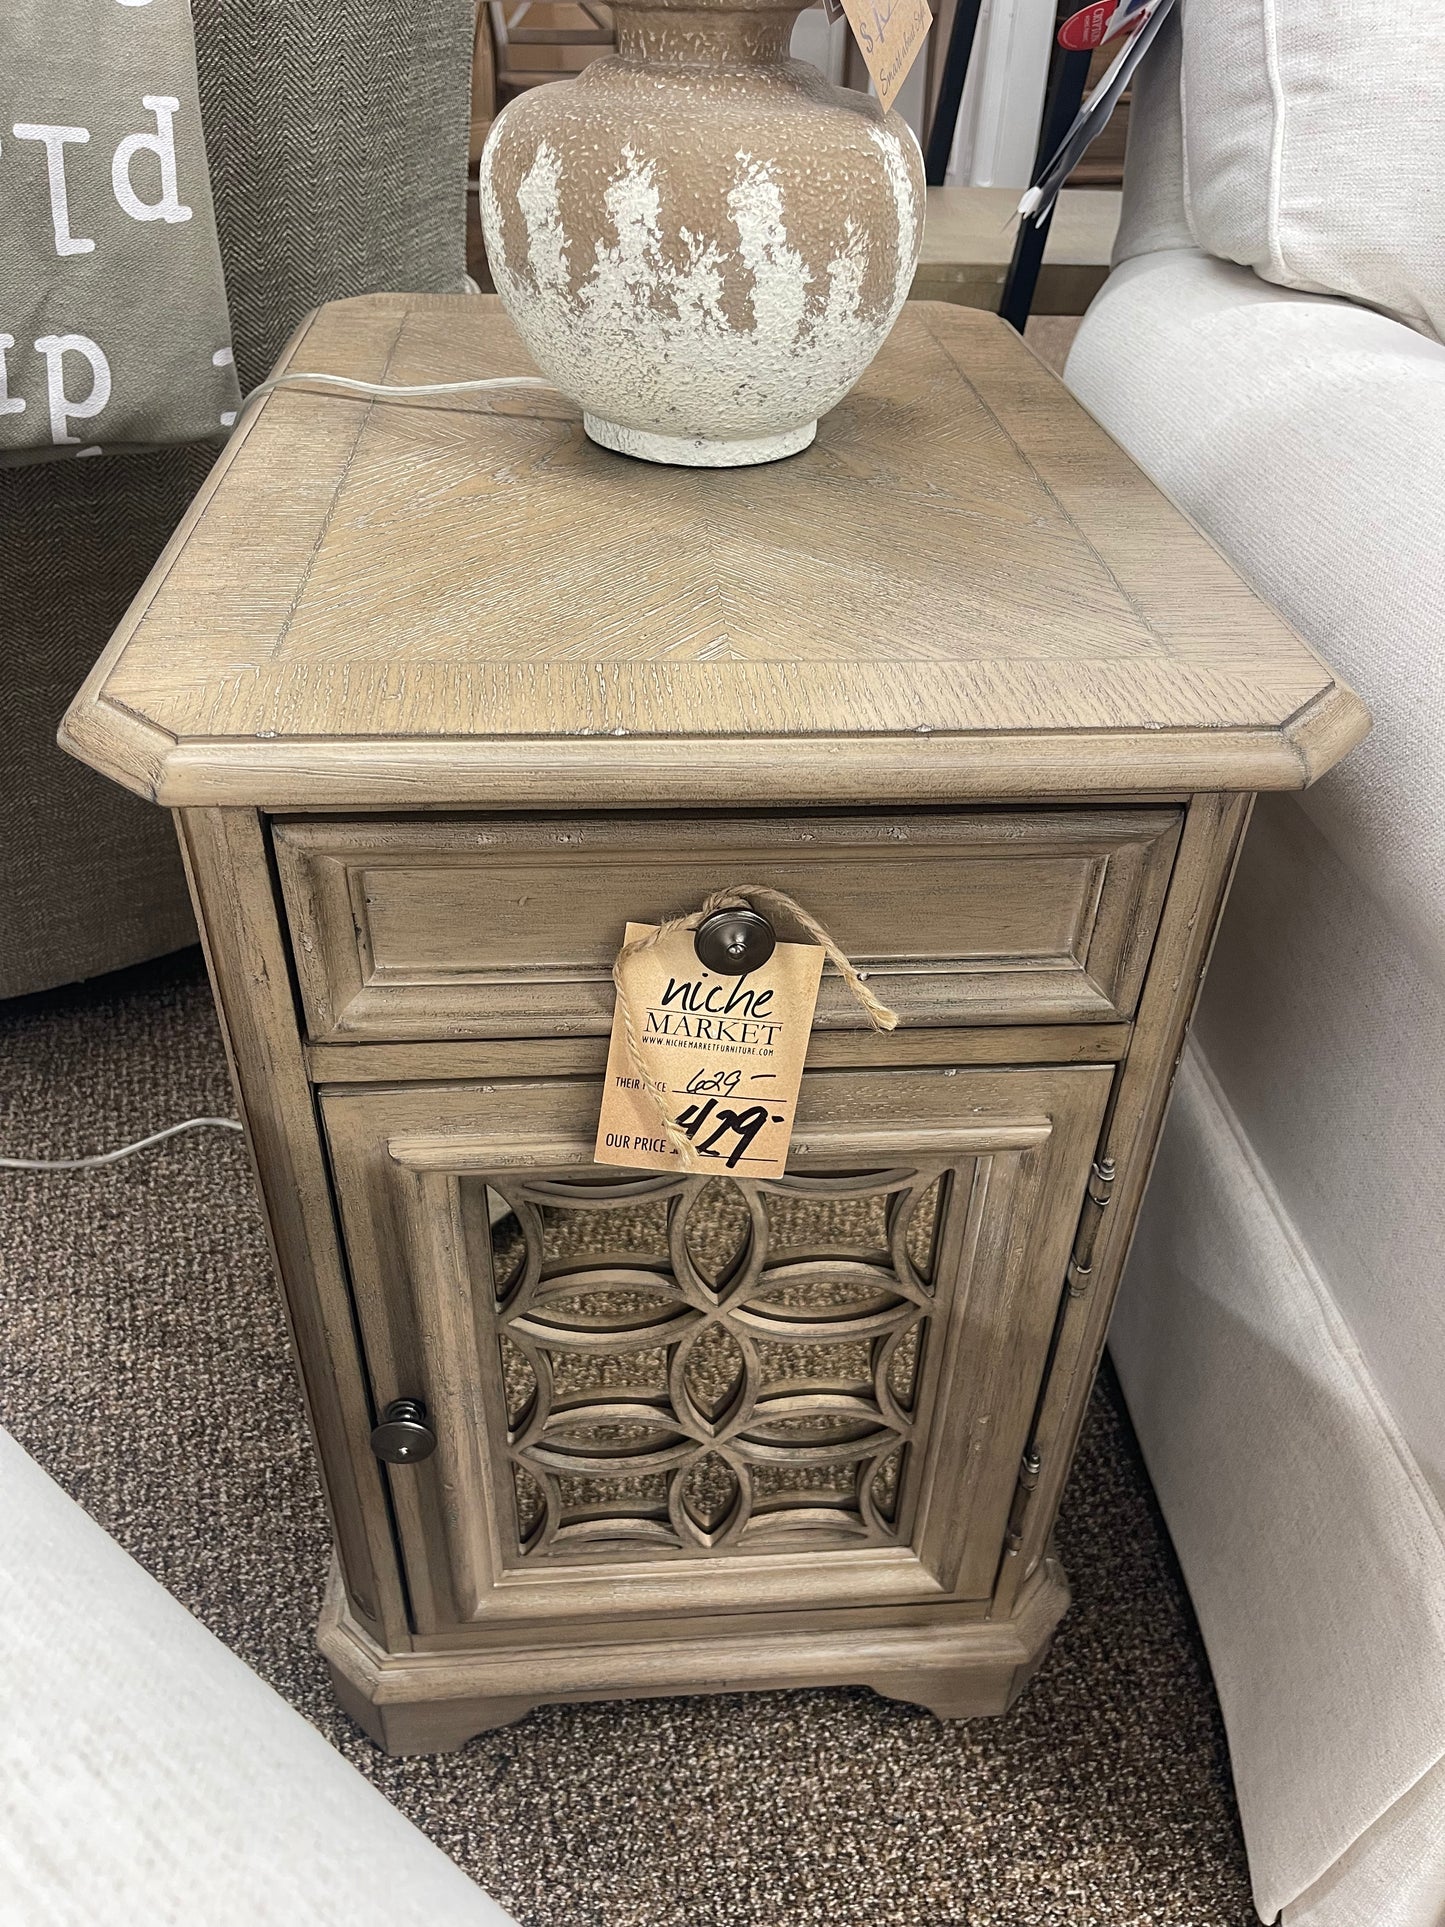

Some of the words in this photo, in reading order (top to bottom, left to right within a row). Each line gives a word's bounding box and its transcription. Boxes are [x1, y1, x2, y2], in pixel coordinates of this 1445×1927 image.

[661, 972, 775, 1018] niche
[643, 1011, 783, 1046] MARKET
[642, 1035, 775, 1057] WWW.NICHEMARKETFURNITURE.COM
[615, 1076, 640, 1090] THEIR
[606, 1133, 631, 1149] OUR
[633, 1136, 667, 1153] PRICE
